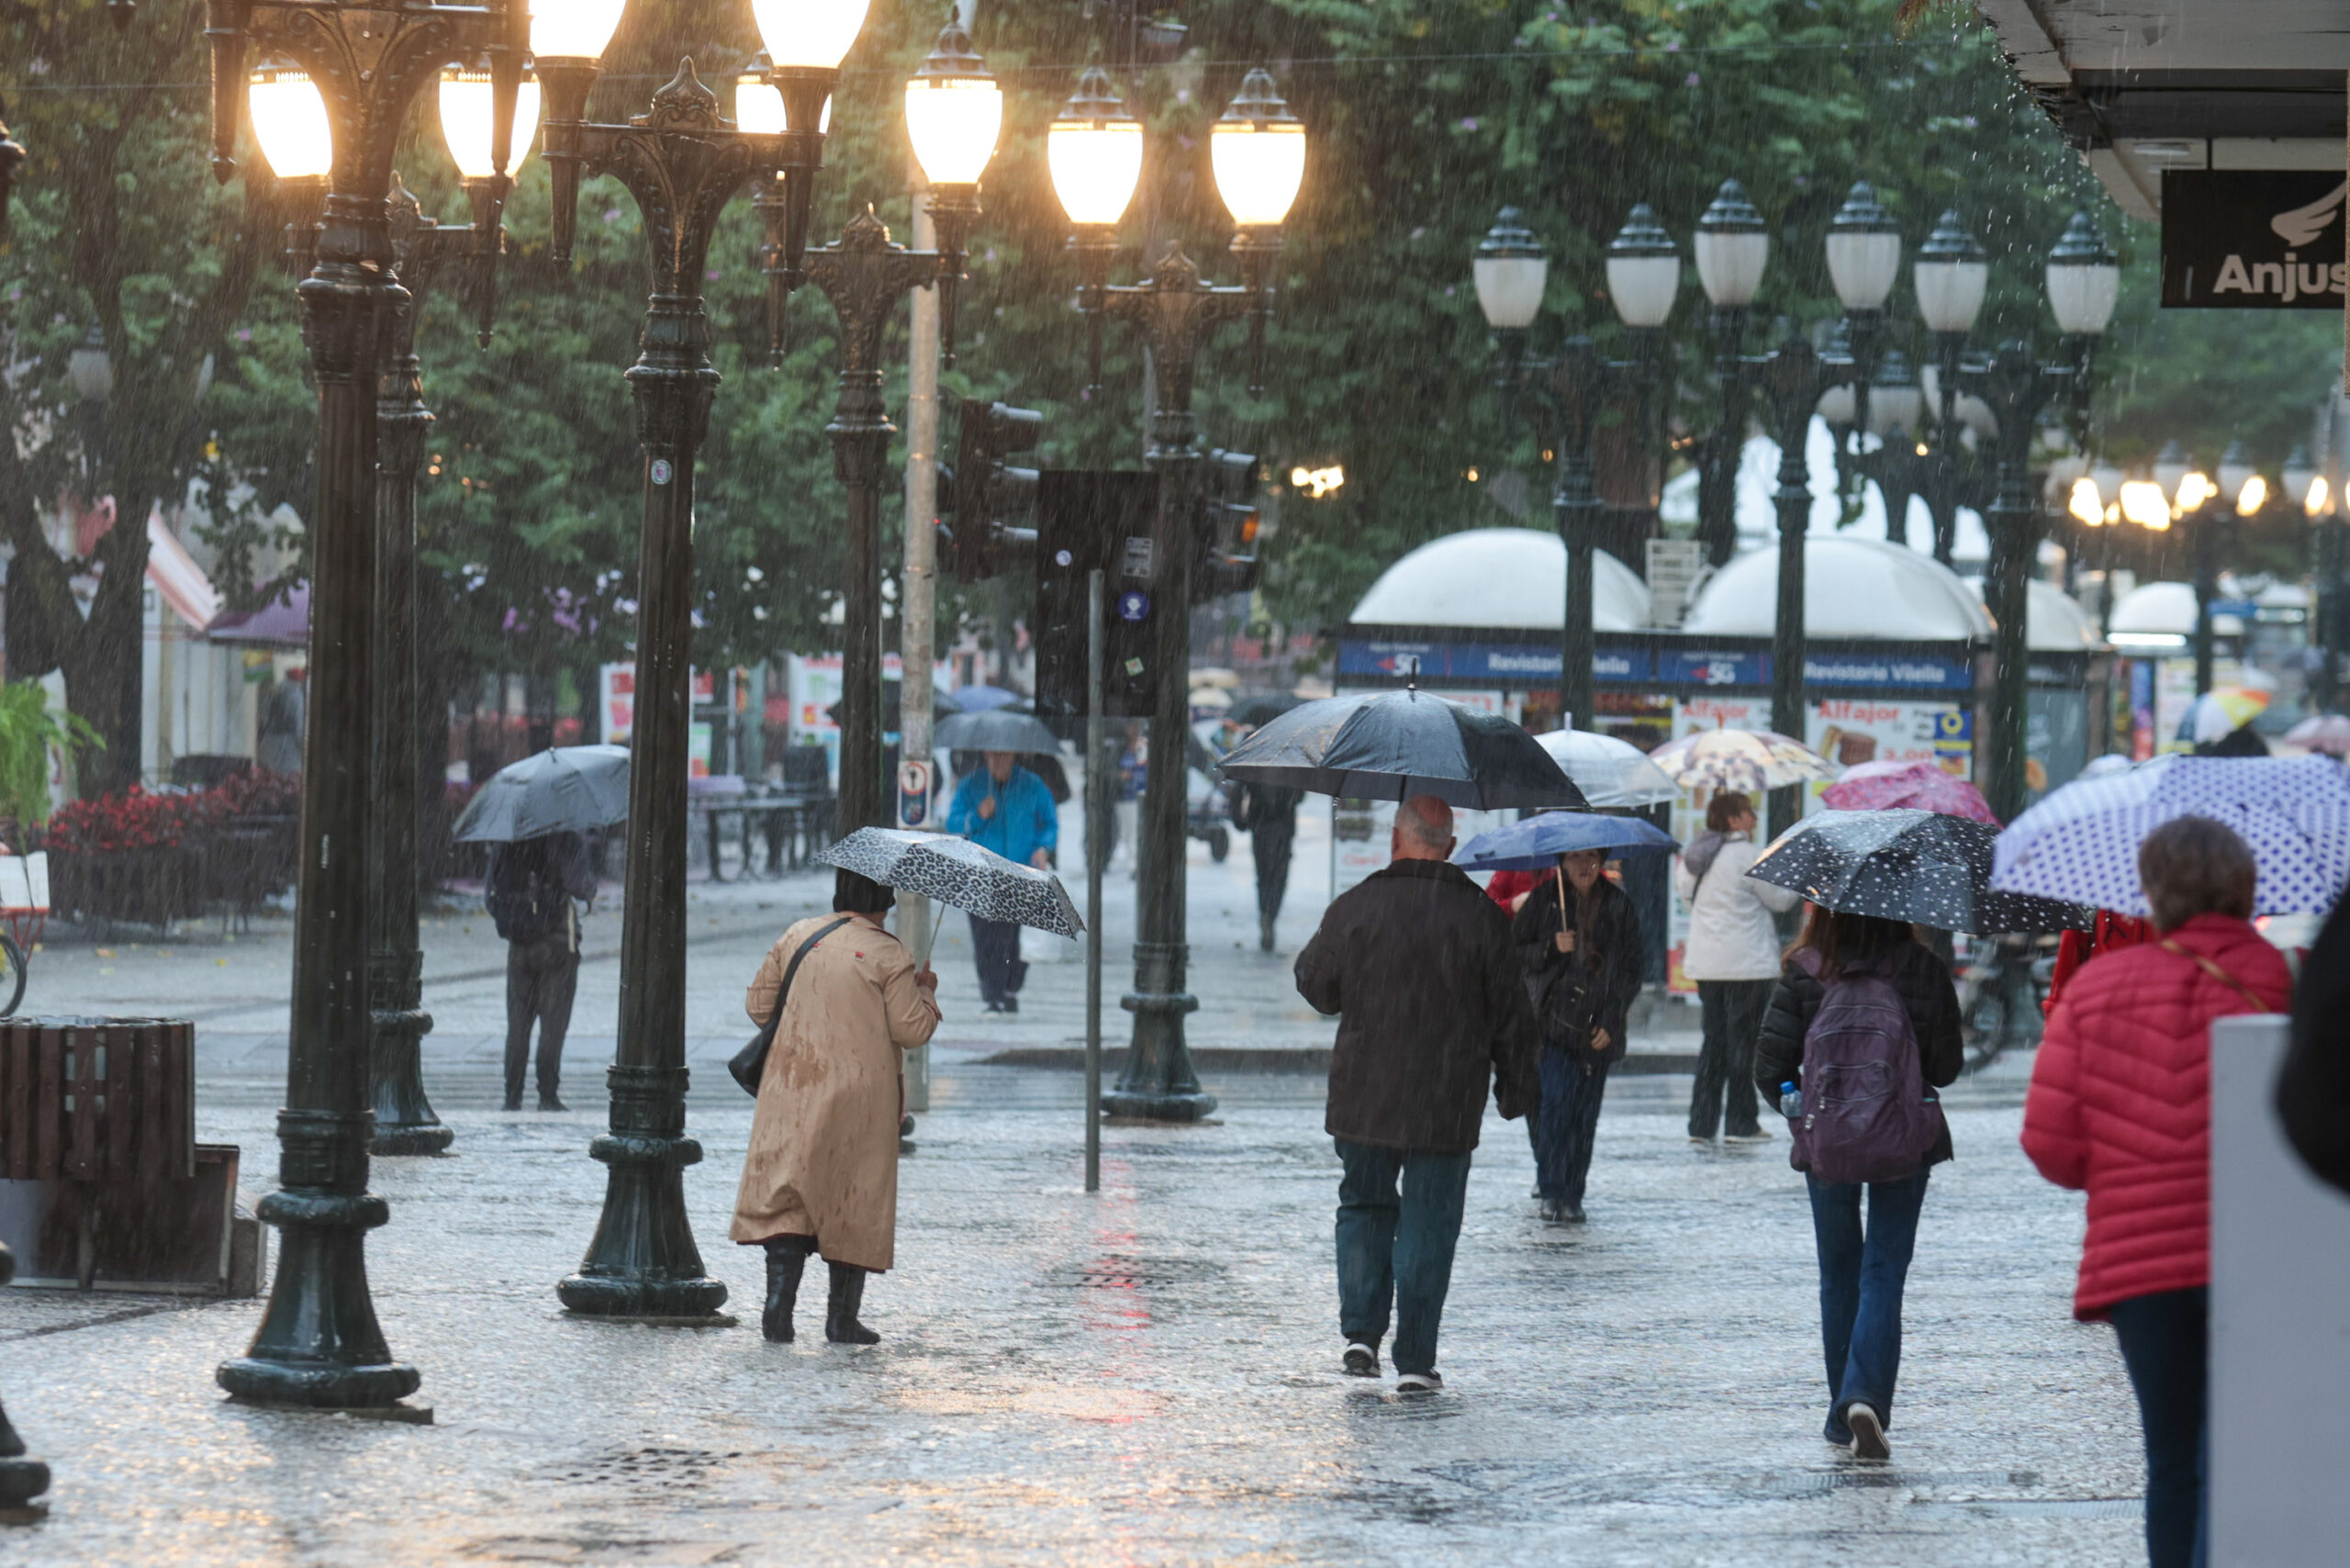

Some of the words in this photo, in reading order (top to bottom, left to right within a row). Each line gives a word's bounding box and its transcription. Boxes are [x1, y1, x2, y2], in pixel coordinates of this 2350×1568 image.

[2213, 252, 2345, 302] Anjus
[1488, 653, 1562, 672] Revistari
[1706, 661, 1736, 685] 5G
[1818, 700, 1899, 724] Alfajor
